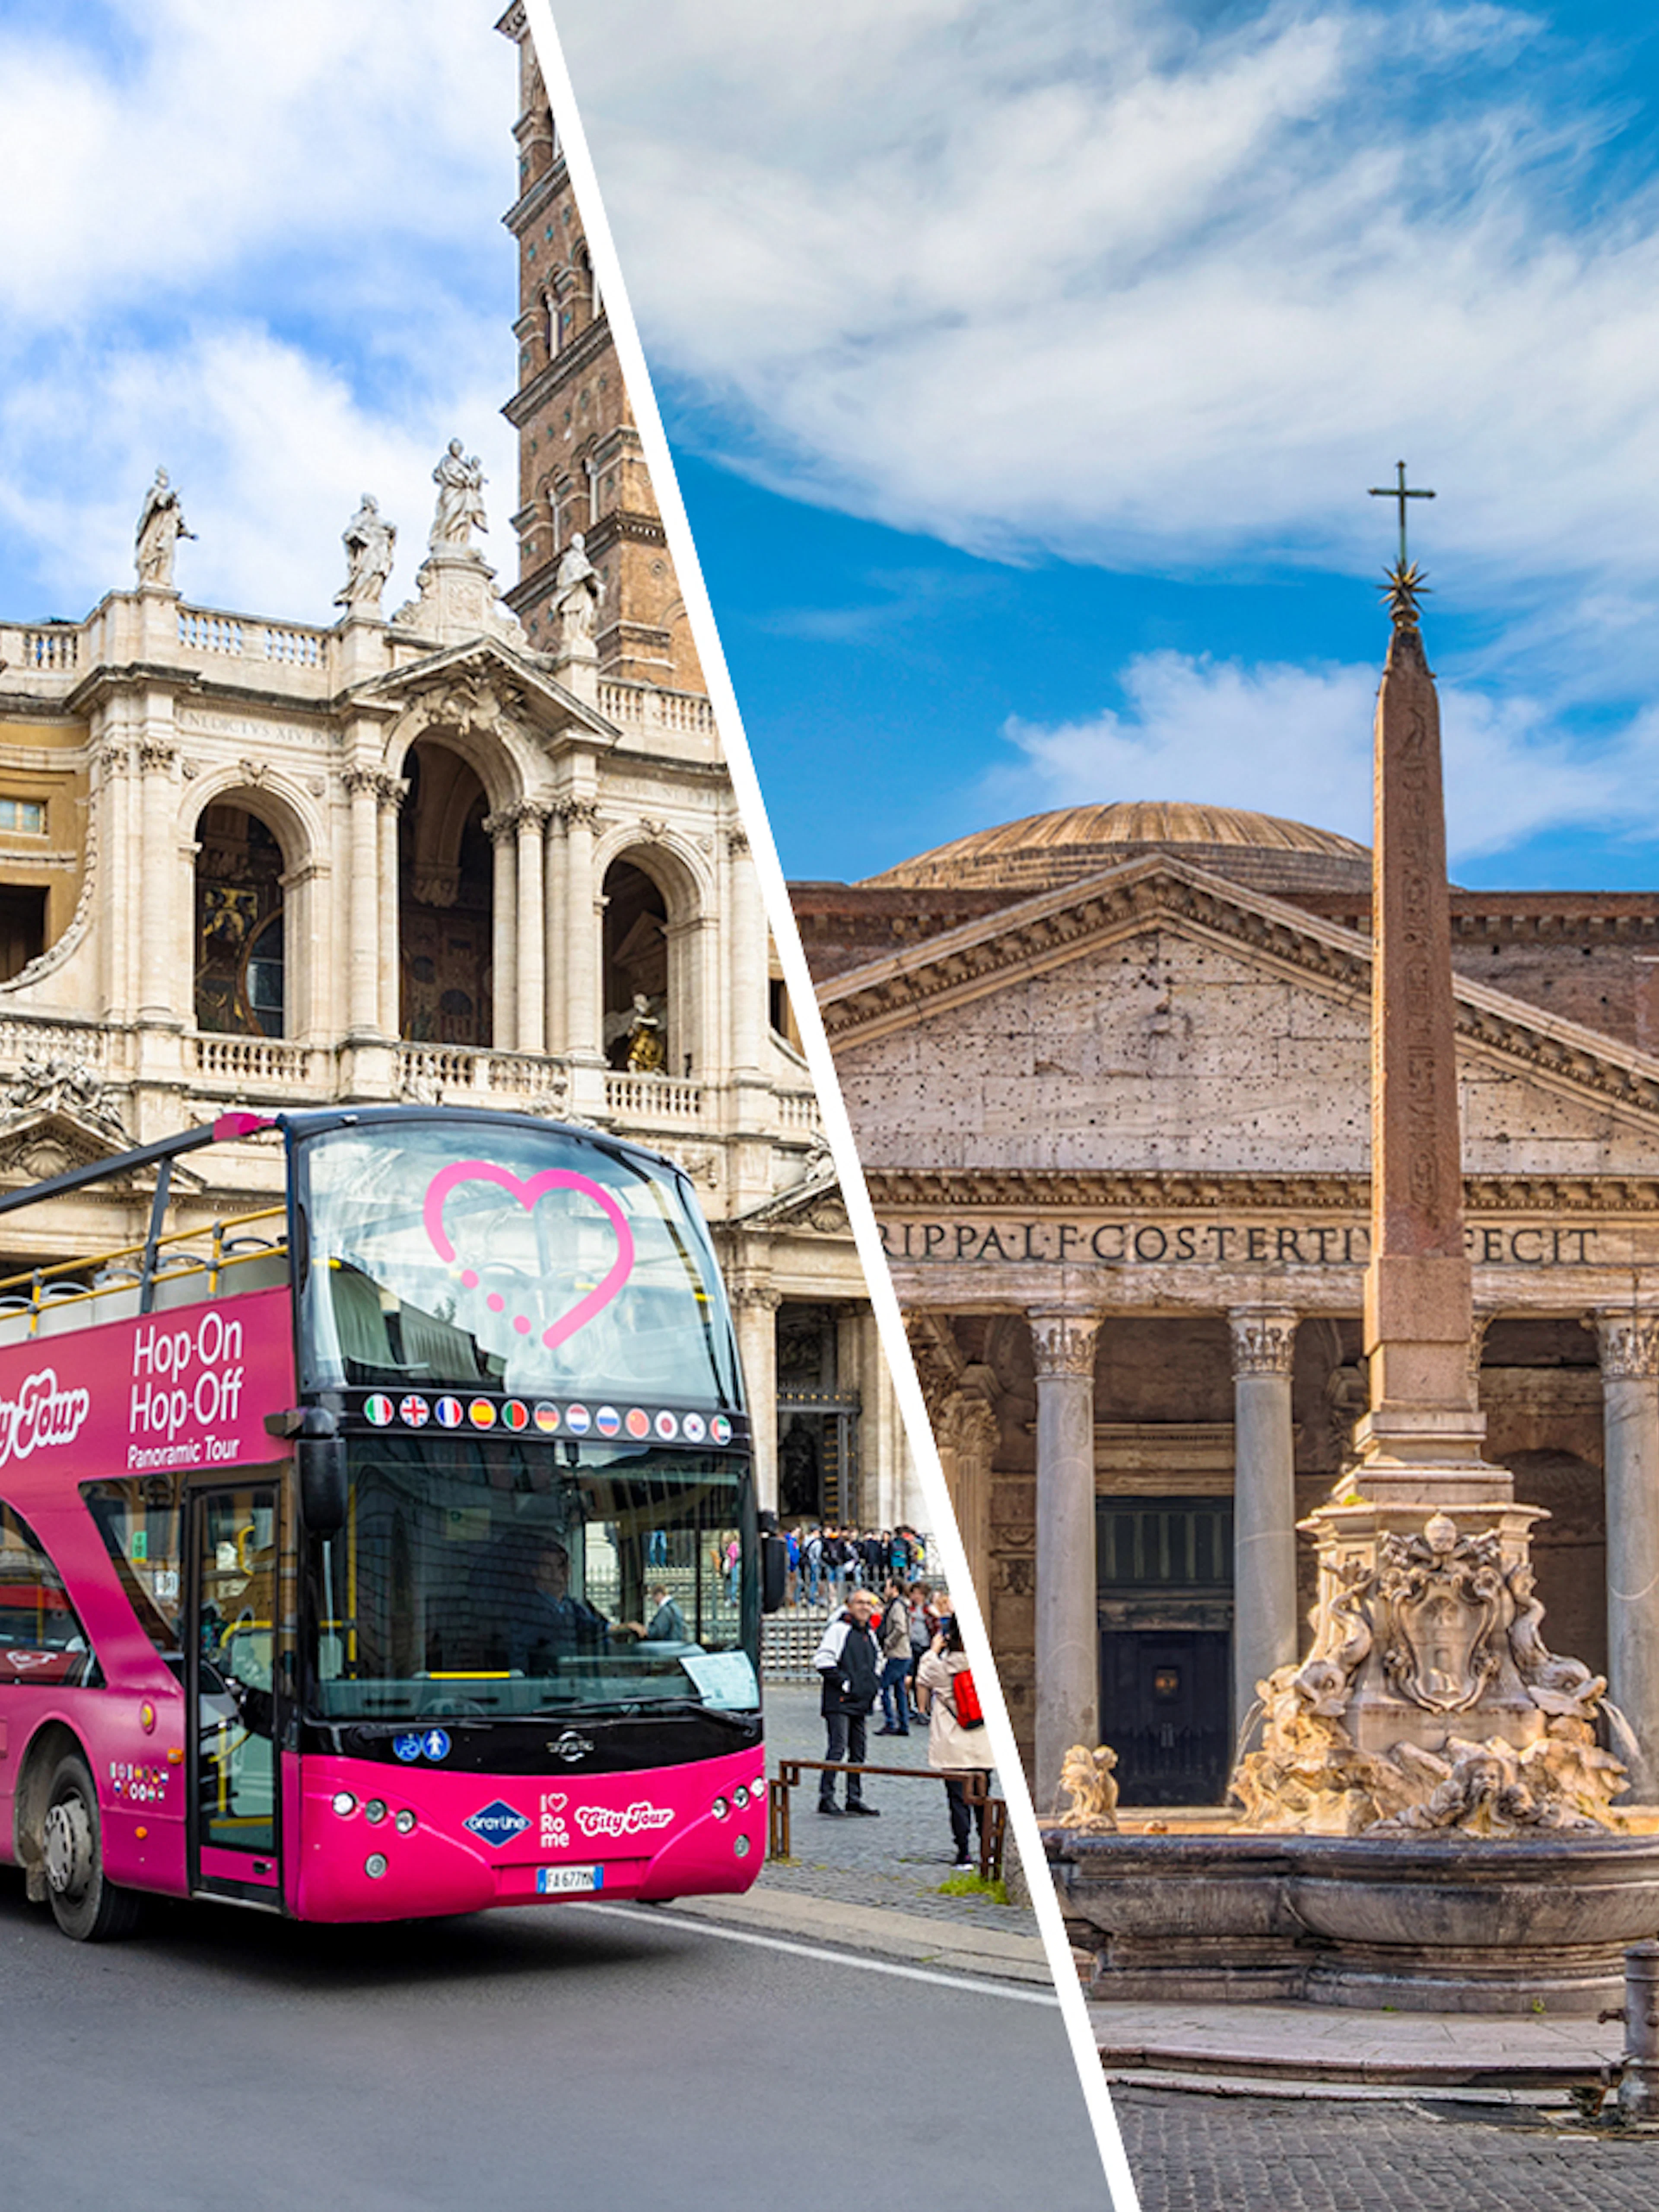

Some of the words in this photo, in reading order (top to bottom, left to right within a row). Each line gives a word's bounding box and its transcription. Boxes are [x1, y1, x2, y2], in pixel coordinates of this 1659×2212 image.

[133, 1311, 242, 1383] Hop-On
[130, 1367, 244, 1441] Hop-Off
[127, 1437, 201, 1469] Panoramic
[204, 1434, 240, 1462] Tour
